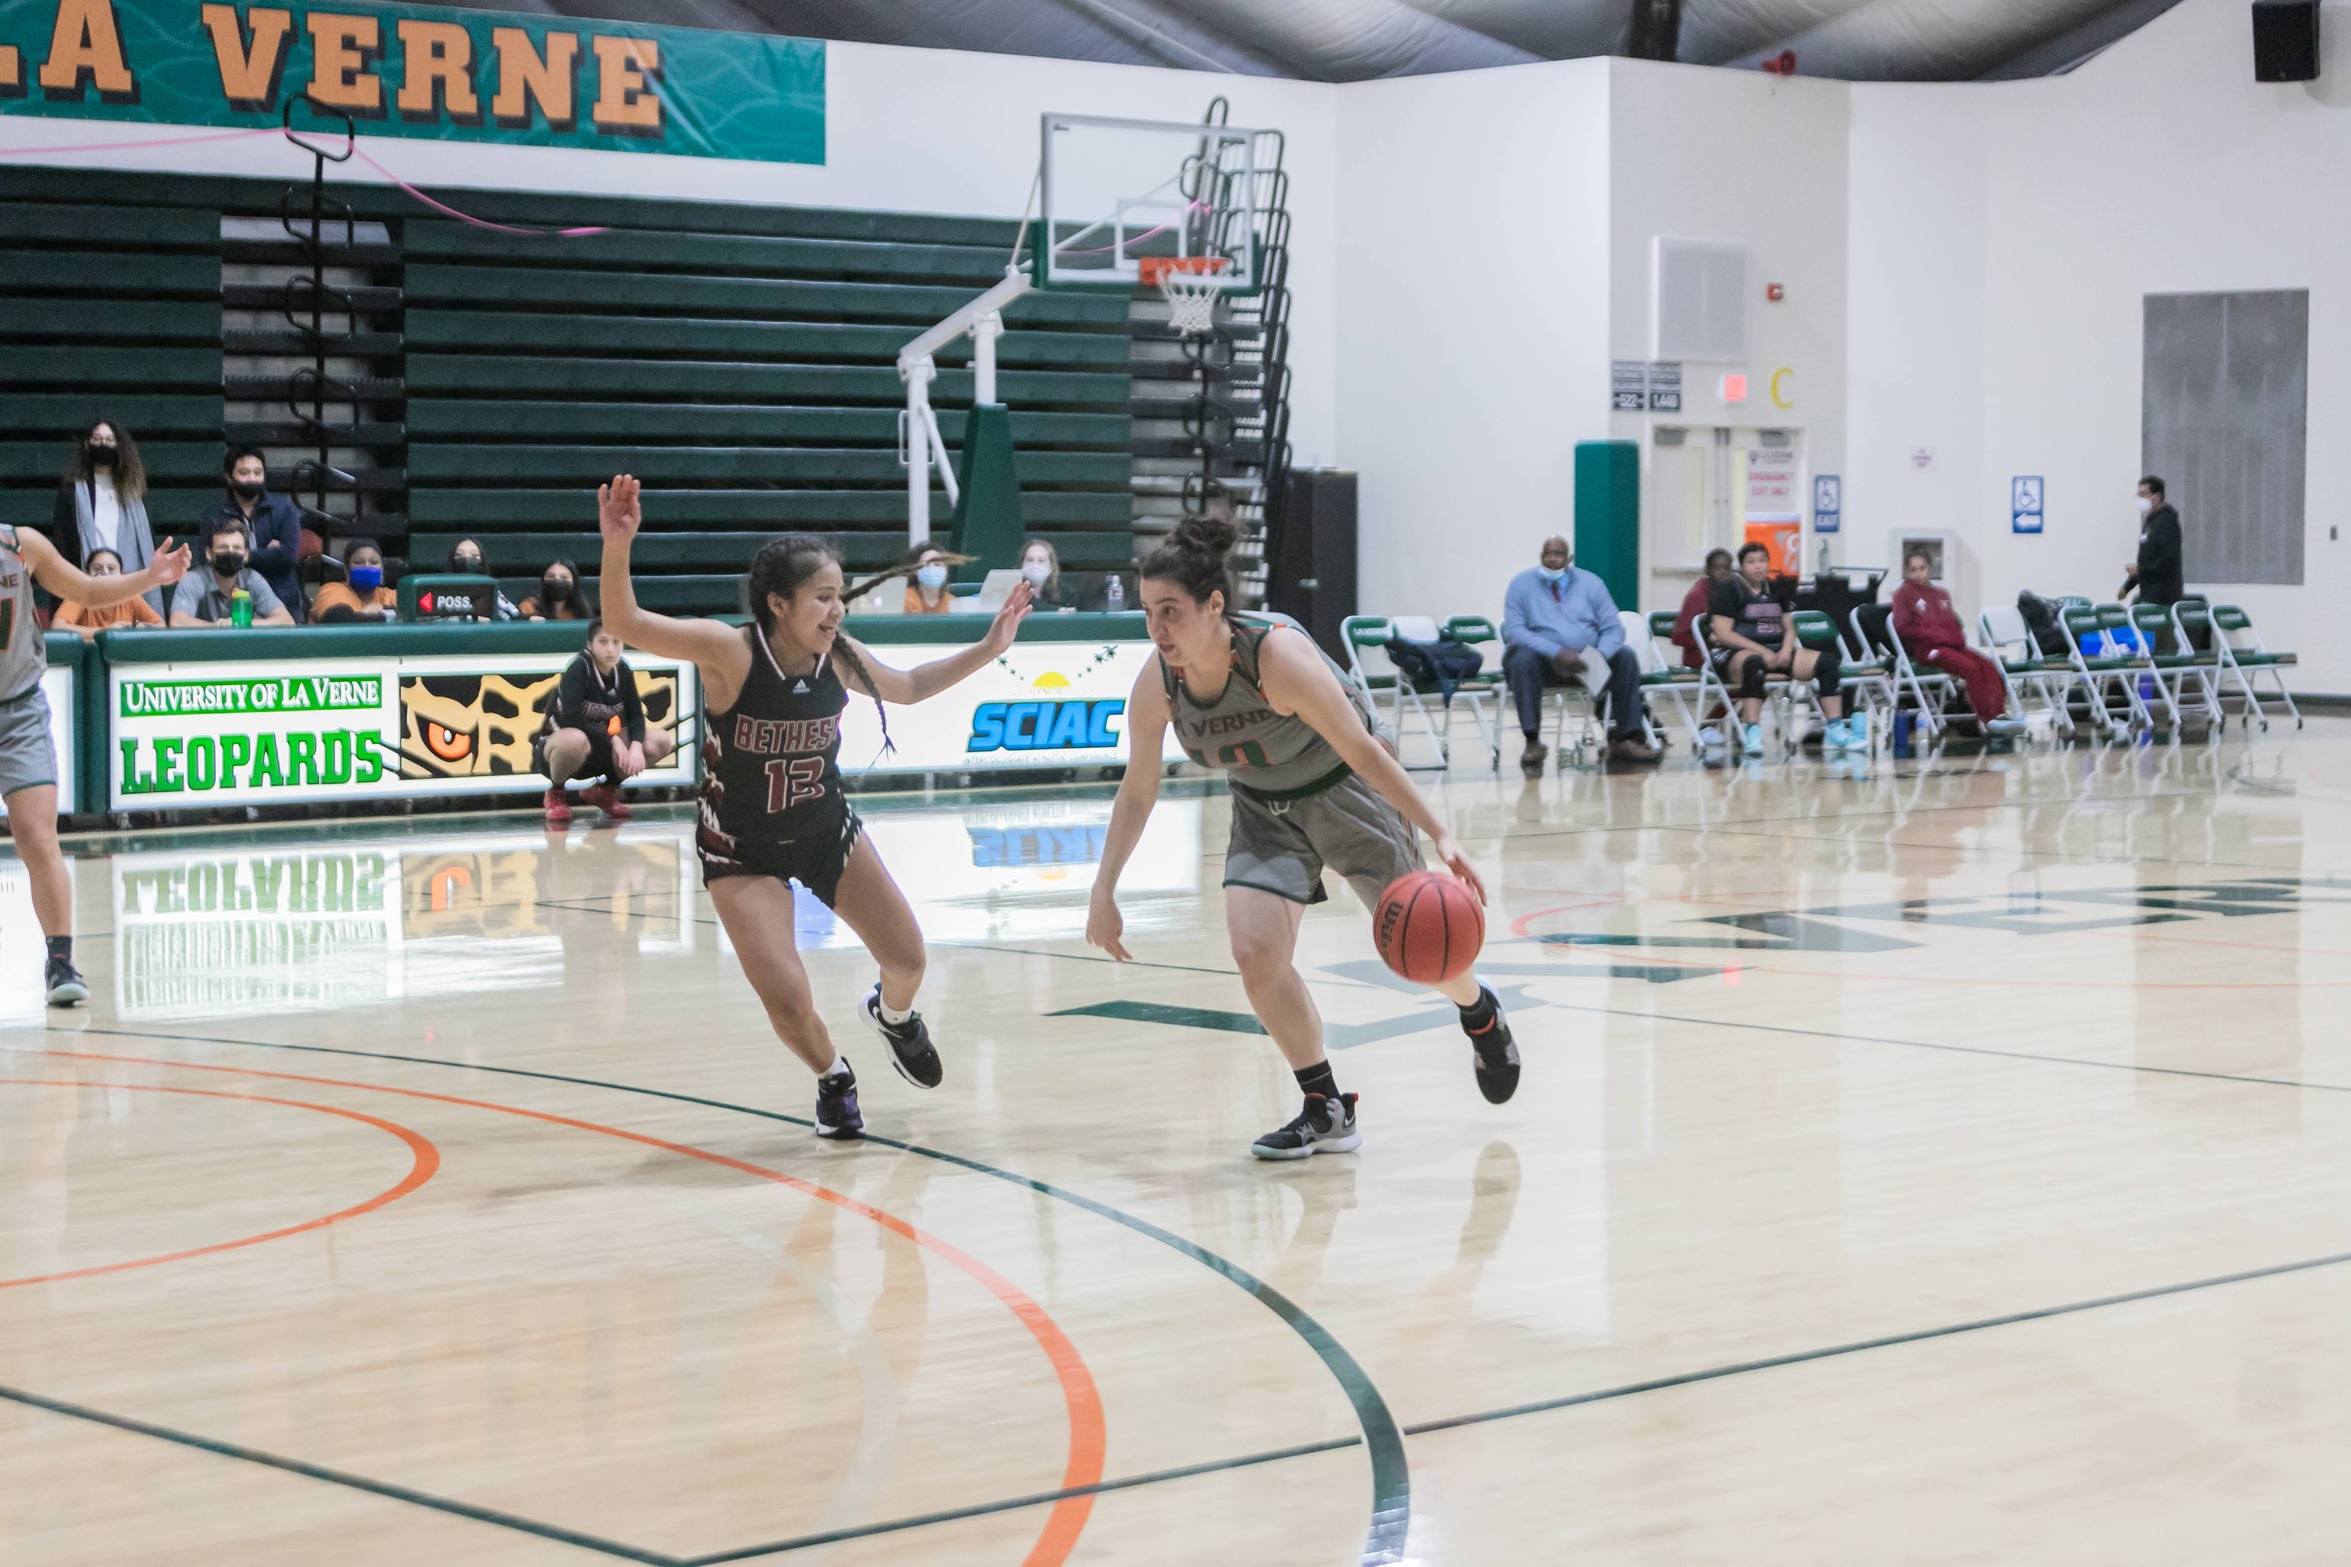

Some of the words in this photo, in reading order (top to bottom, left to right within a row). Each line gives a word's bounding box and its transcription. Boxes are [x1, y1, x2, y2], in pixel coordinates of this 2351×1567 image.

[0, 0, 141, 104] A
[201, 2, 667, 142] VERNE
[1769, 366, 1795, 410] C
[250, 682, 279, 710] OF
[280, 677, 311, 708] LA
[311, 676, 380, 708] VERNE
[734, 714, 842, 754] BETHES
[966, 697, 1127, 753] SCIAC
[119, 728, 384, 795] LEOPARDS
[764, 755, 826, 814] 13
